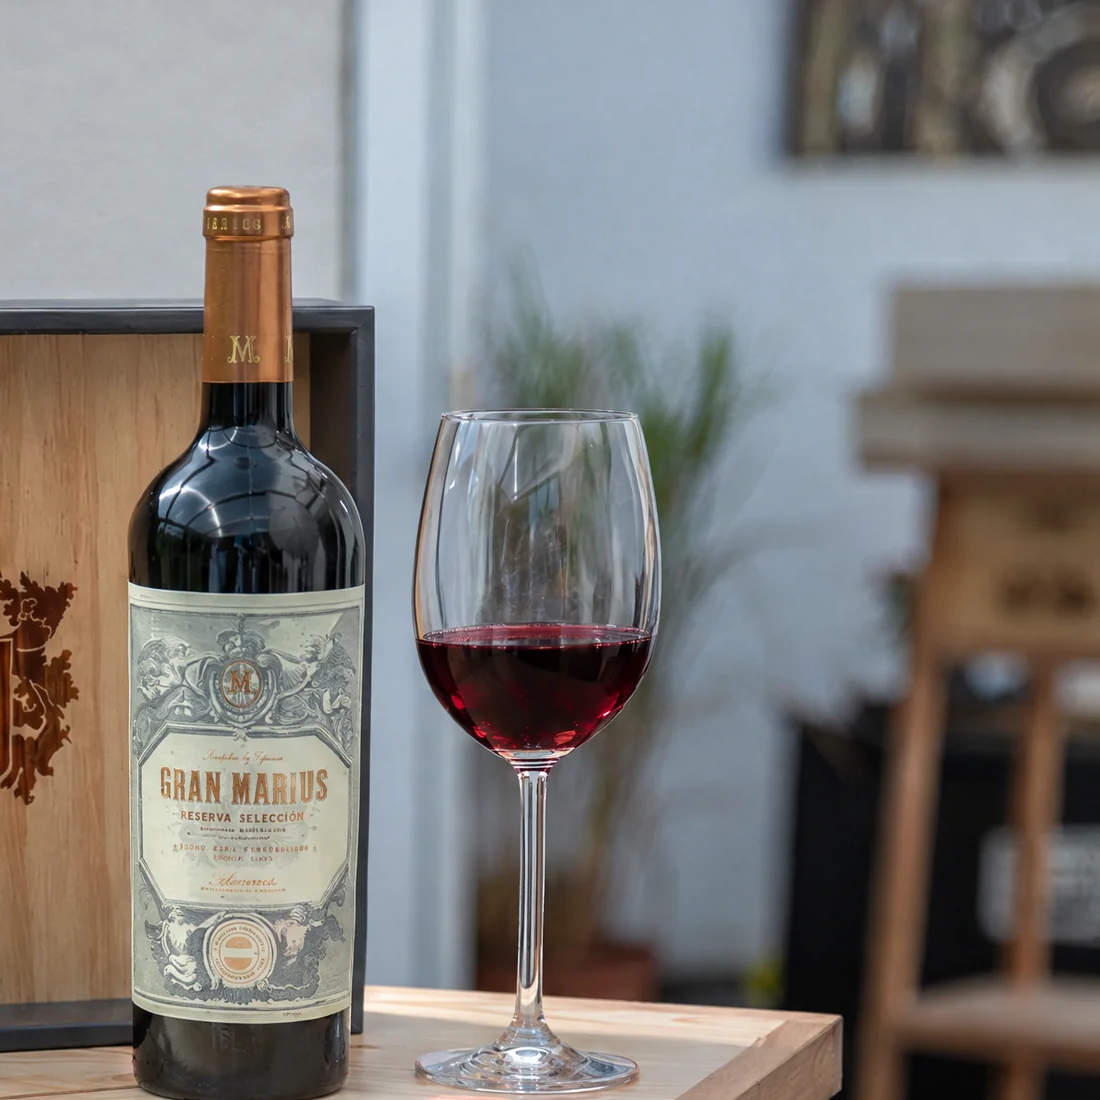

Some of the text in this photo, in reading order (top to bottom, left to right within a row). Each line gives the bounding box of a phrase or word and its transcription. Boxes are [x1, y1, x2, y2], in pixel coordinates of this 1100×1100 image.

[160, 766, 328, 806] GRAN MARIUS
[181, 810, 304, 824] RESERVA SELECCIÓN
